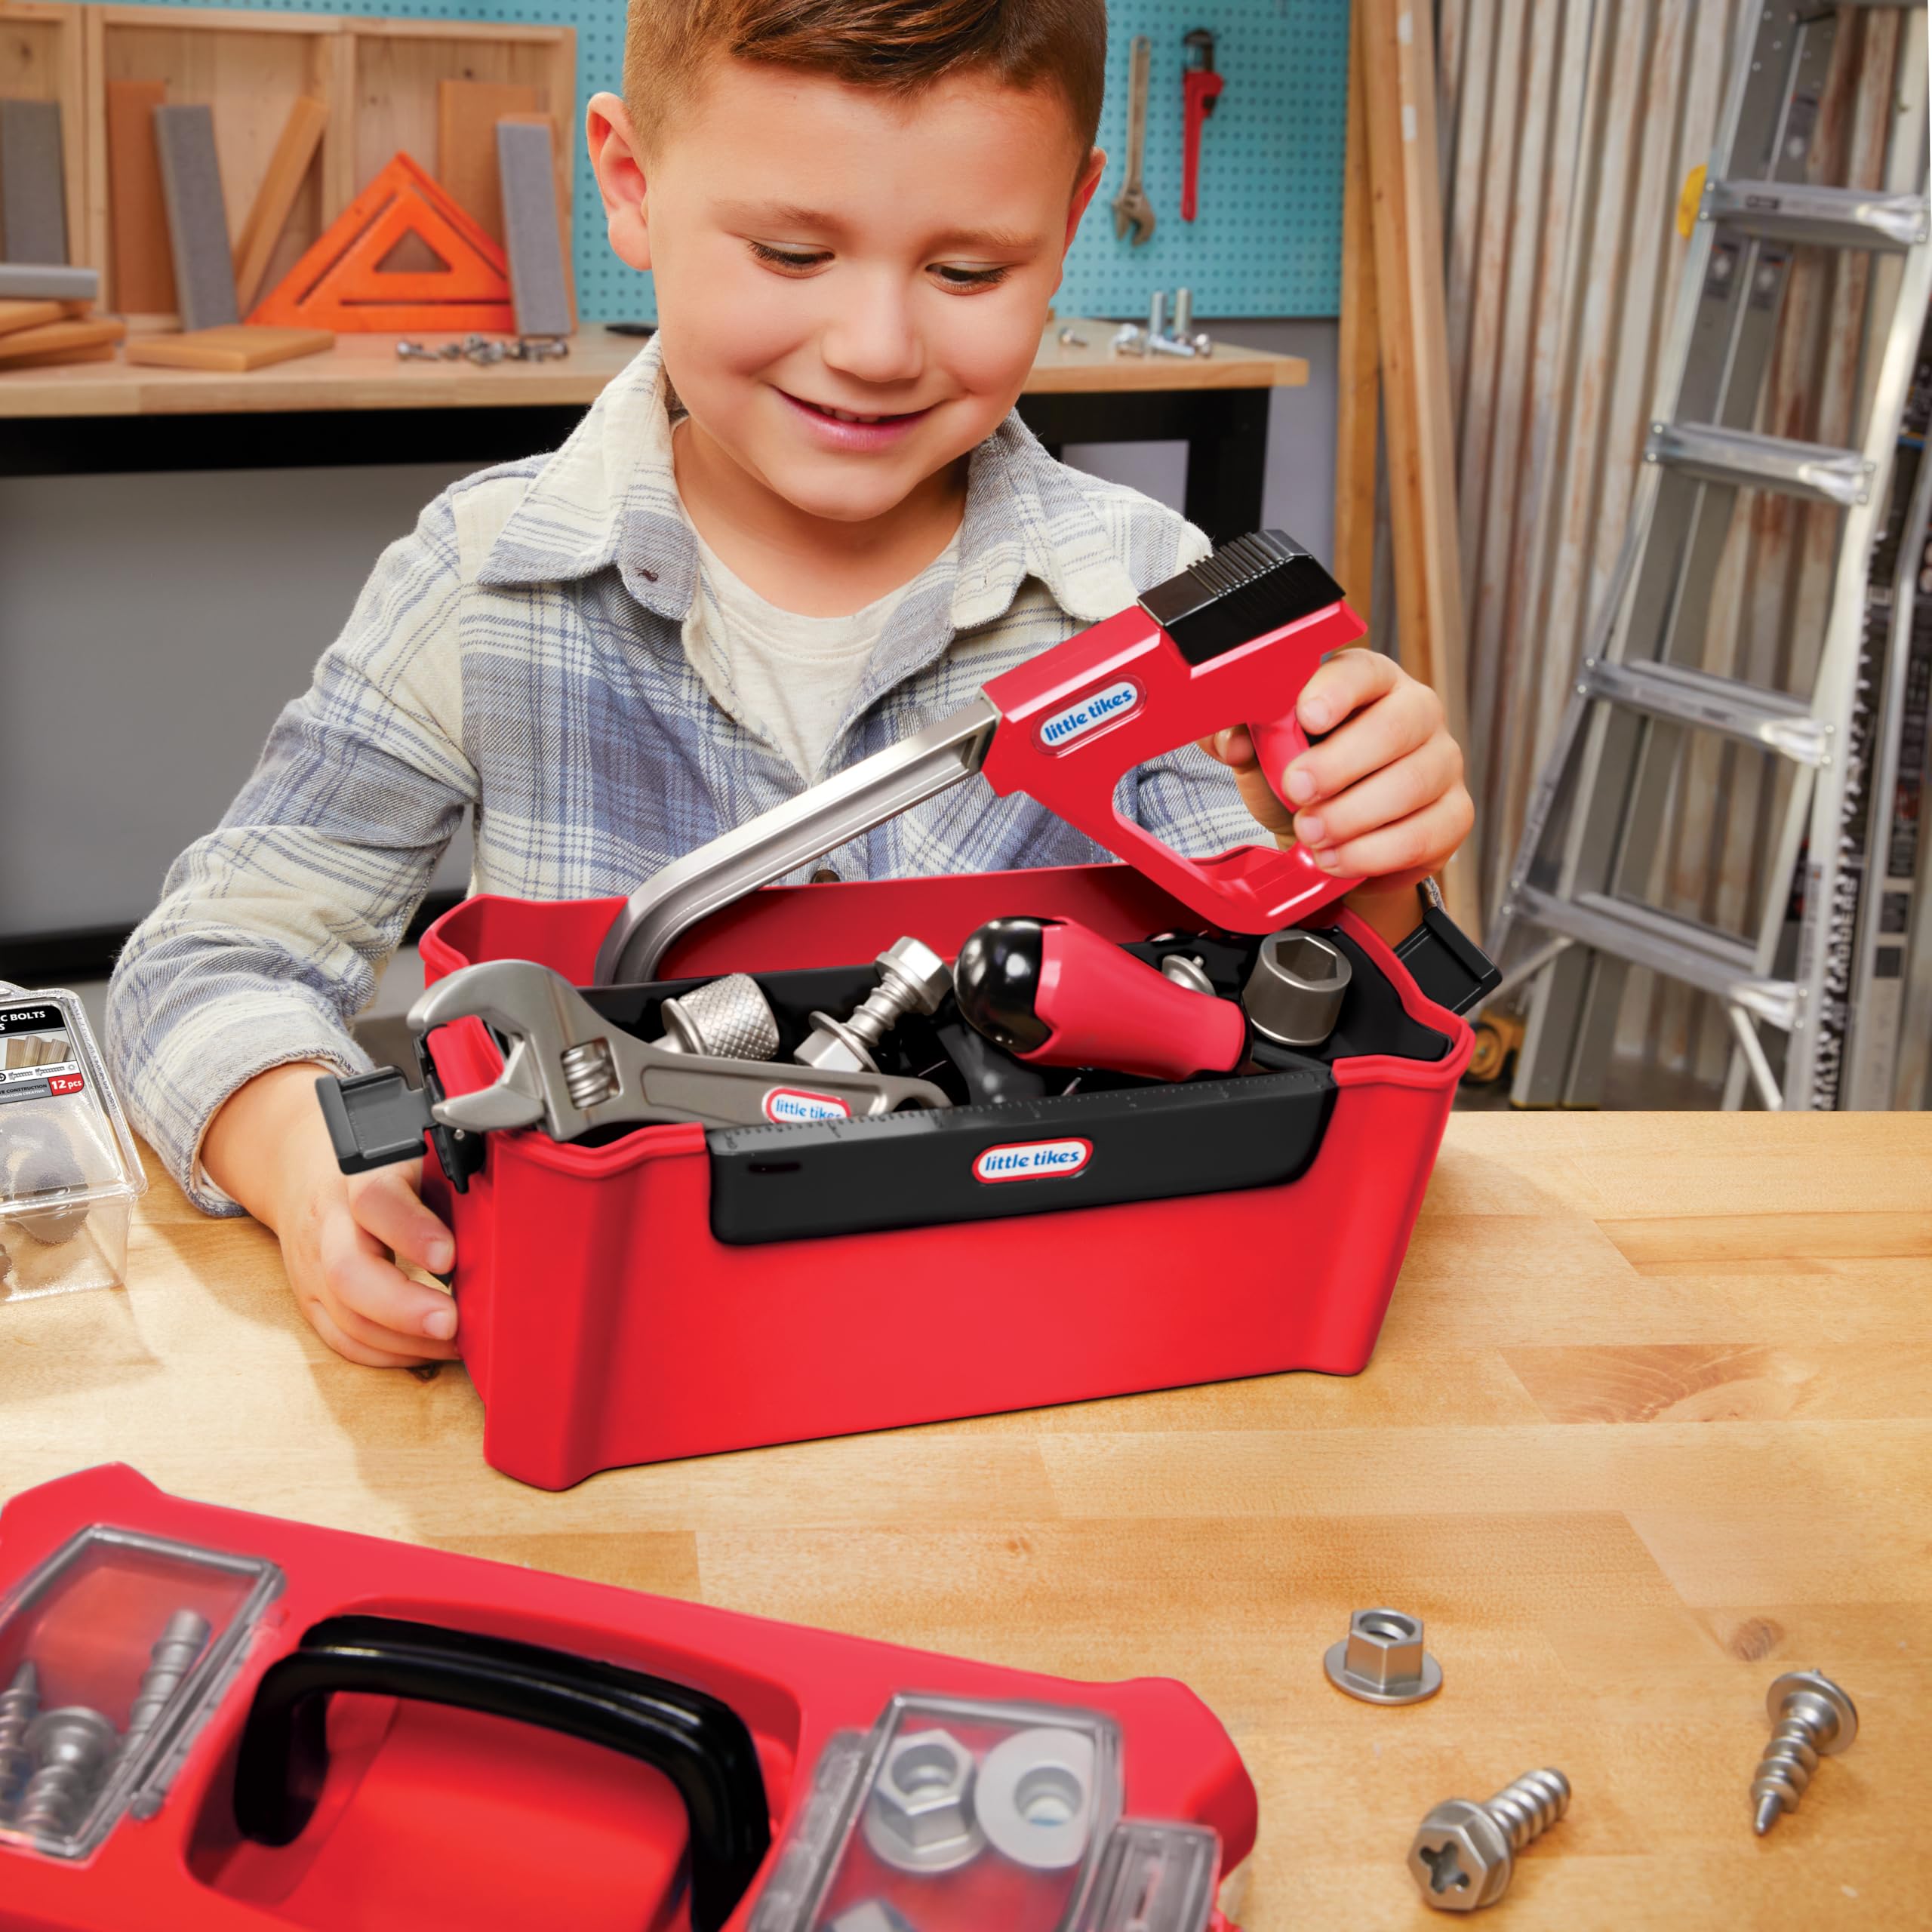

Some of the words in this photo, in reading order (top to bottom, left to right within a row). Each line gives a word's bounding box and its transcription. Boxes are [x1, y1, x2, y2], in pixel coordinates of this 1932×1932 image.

[1044, 713, 1088, 742] little
[1088, 690, 1133, 718] tikes
[10, 1011, 46, 1021] BOLTS
[6, 1084, 47, 1094] CONSTRUCTION
[51, 1079, 67, 1090] 12
[67, 1080, 82, 1090] pcs
[776, 1099, 807, 1117] little
[985, 1154, 1030, 1171] little
[1033, 1150, 1079, 1166] tikes
